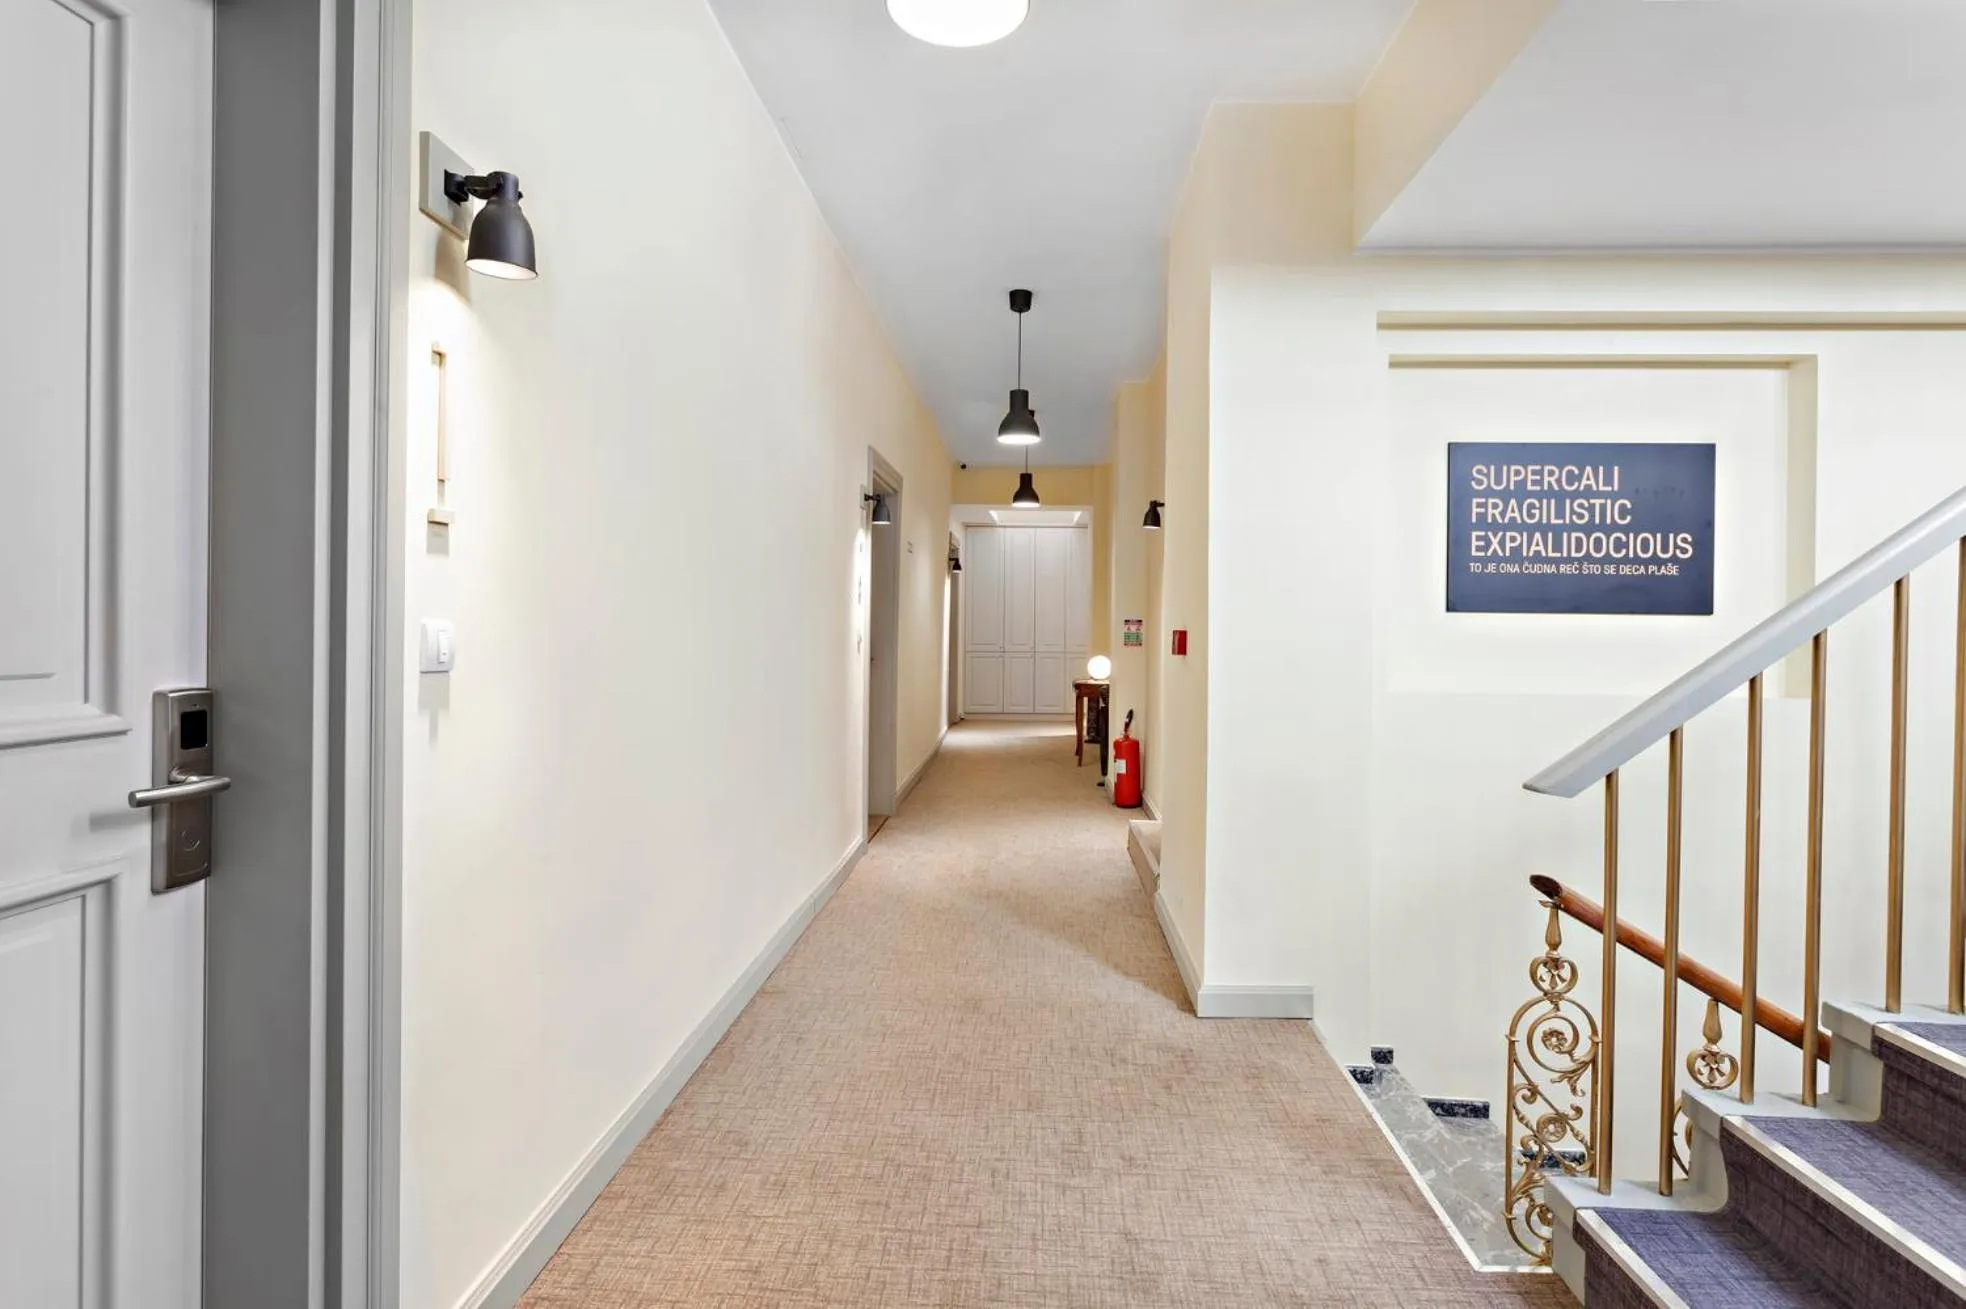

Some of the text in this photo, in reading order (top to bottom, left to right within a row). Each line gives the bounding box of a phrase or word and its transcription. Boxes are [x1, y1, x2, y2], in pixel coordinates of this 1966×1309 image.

[1471, 464, 1619, 491] SUPERCALI
[1471, 498, 1632, 525] FRAGILISTIC
[1471, 532, 1693, 559] EXPIALIDOCIOUS
[1469, 561, 1679, 576] TO JE ONA ČUDNA REČ ŠTO SE DECA PLAŠE
